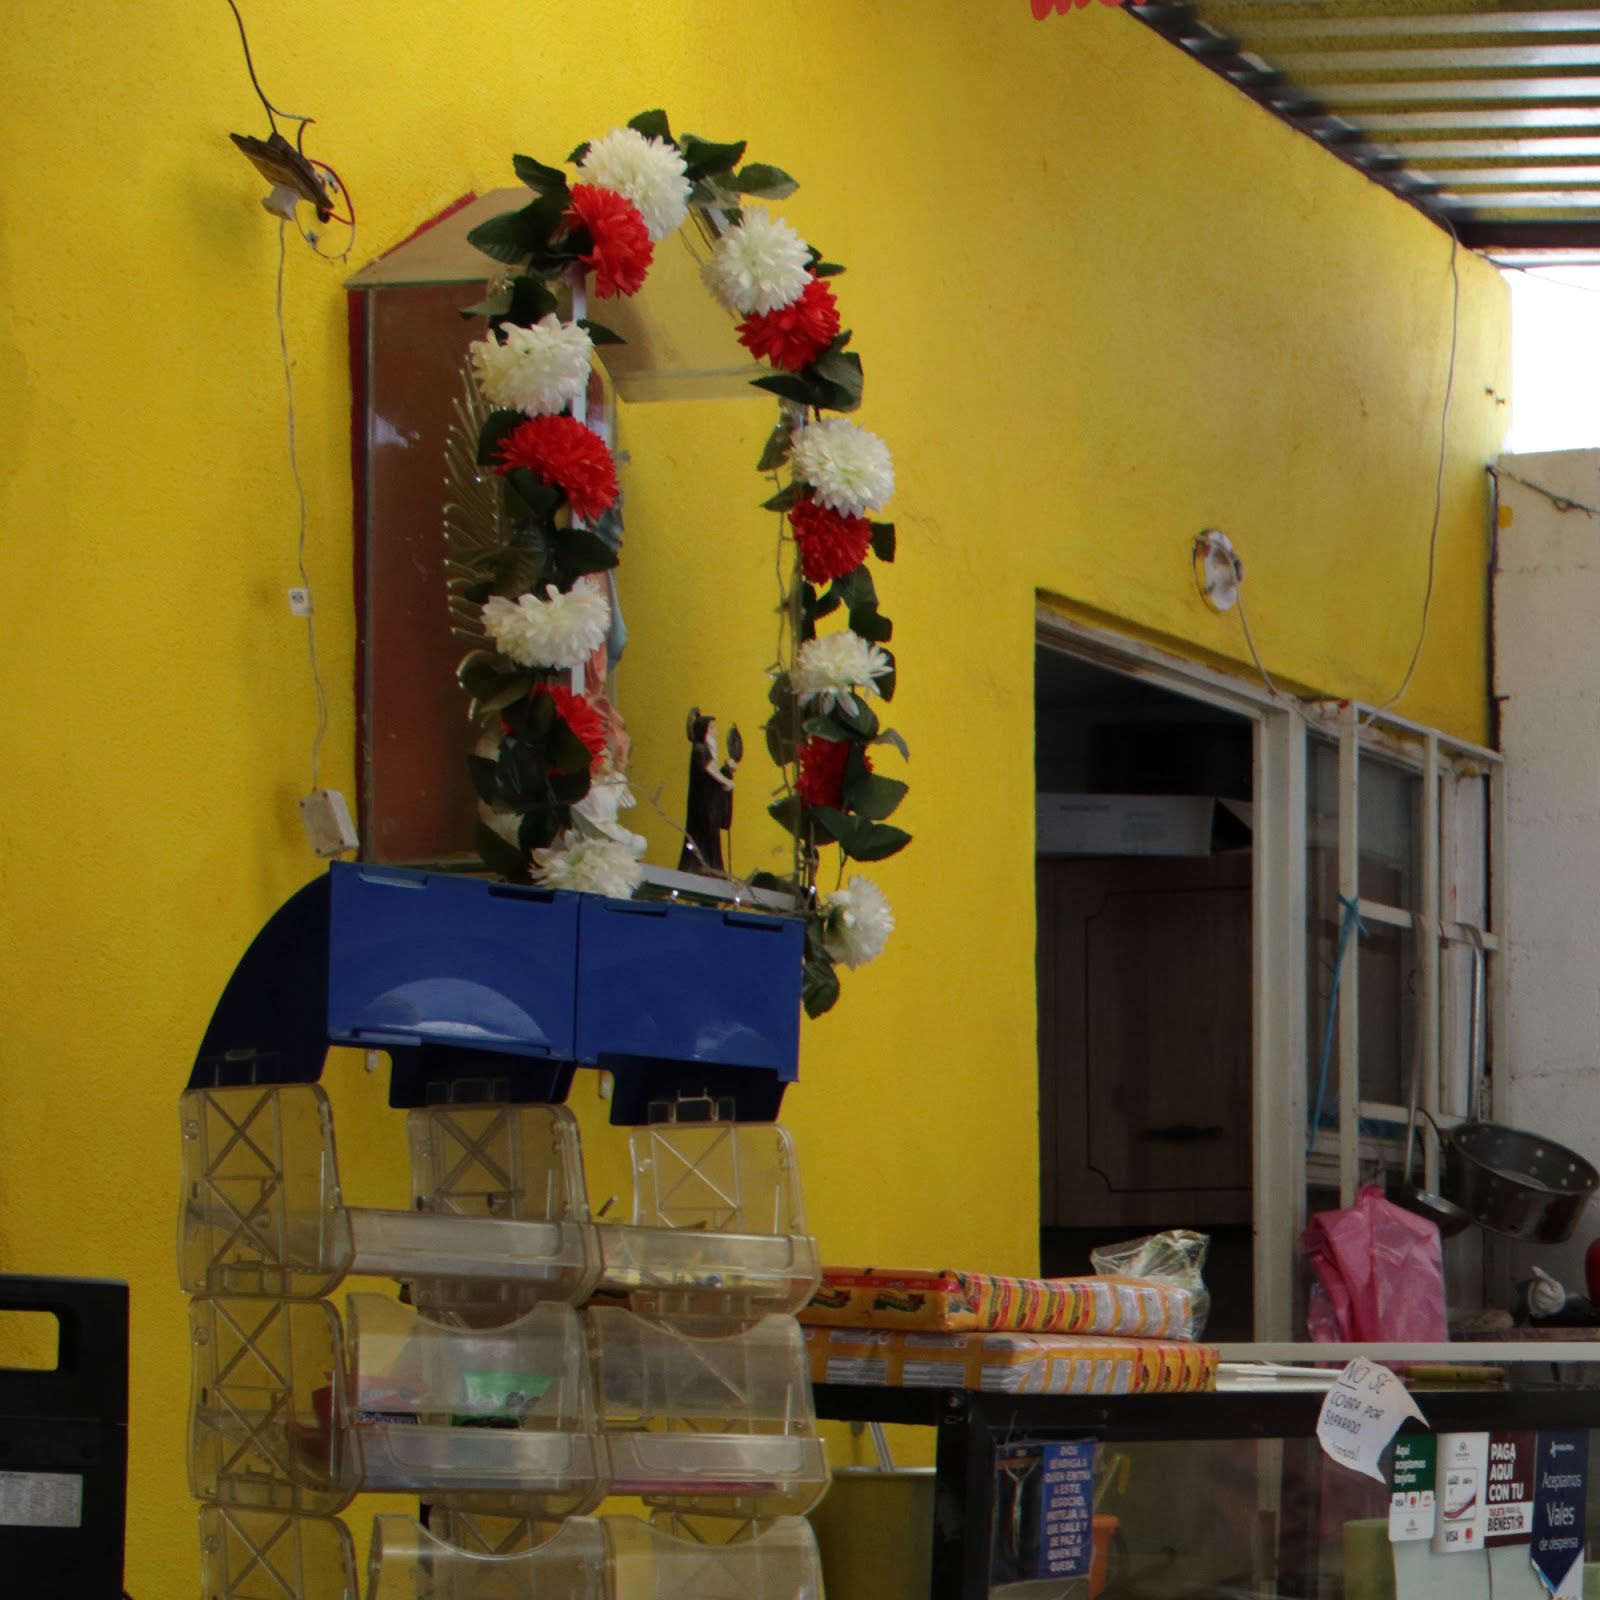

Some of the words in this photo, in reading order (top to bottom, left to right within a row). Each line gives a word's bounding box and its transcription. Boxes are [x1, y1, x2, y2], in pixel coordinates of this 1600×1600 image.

[1343, 1360, 1370, 1384] NO
[1368, 1373, 1392, 1394] SE
[1490, 1442, 1517, 1461] PAGA
[1488, 1483, 1510, 1502] CON
[1511, 1482, 1525, 1500] TU
[1541, 1472, 1582, 1492] Aceptamos
[1546, 1502, 1576, 1528] Vales
[1445, 1531, 1458, 1542] VISA
[1539, 1538, 1548, 1552] de
[1549, 1536, 1579, 1553] despensa
